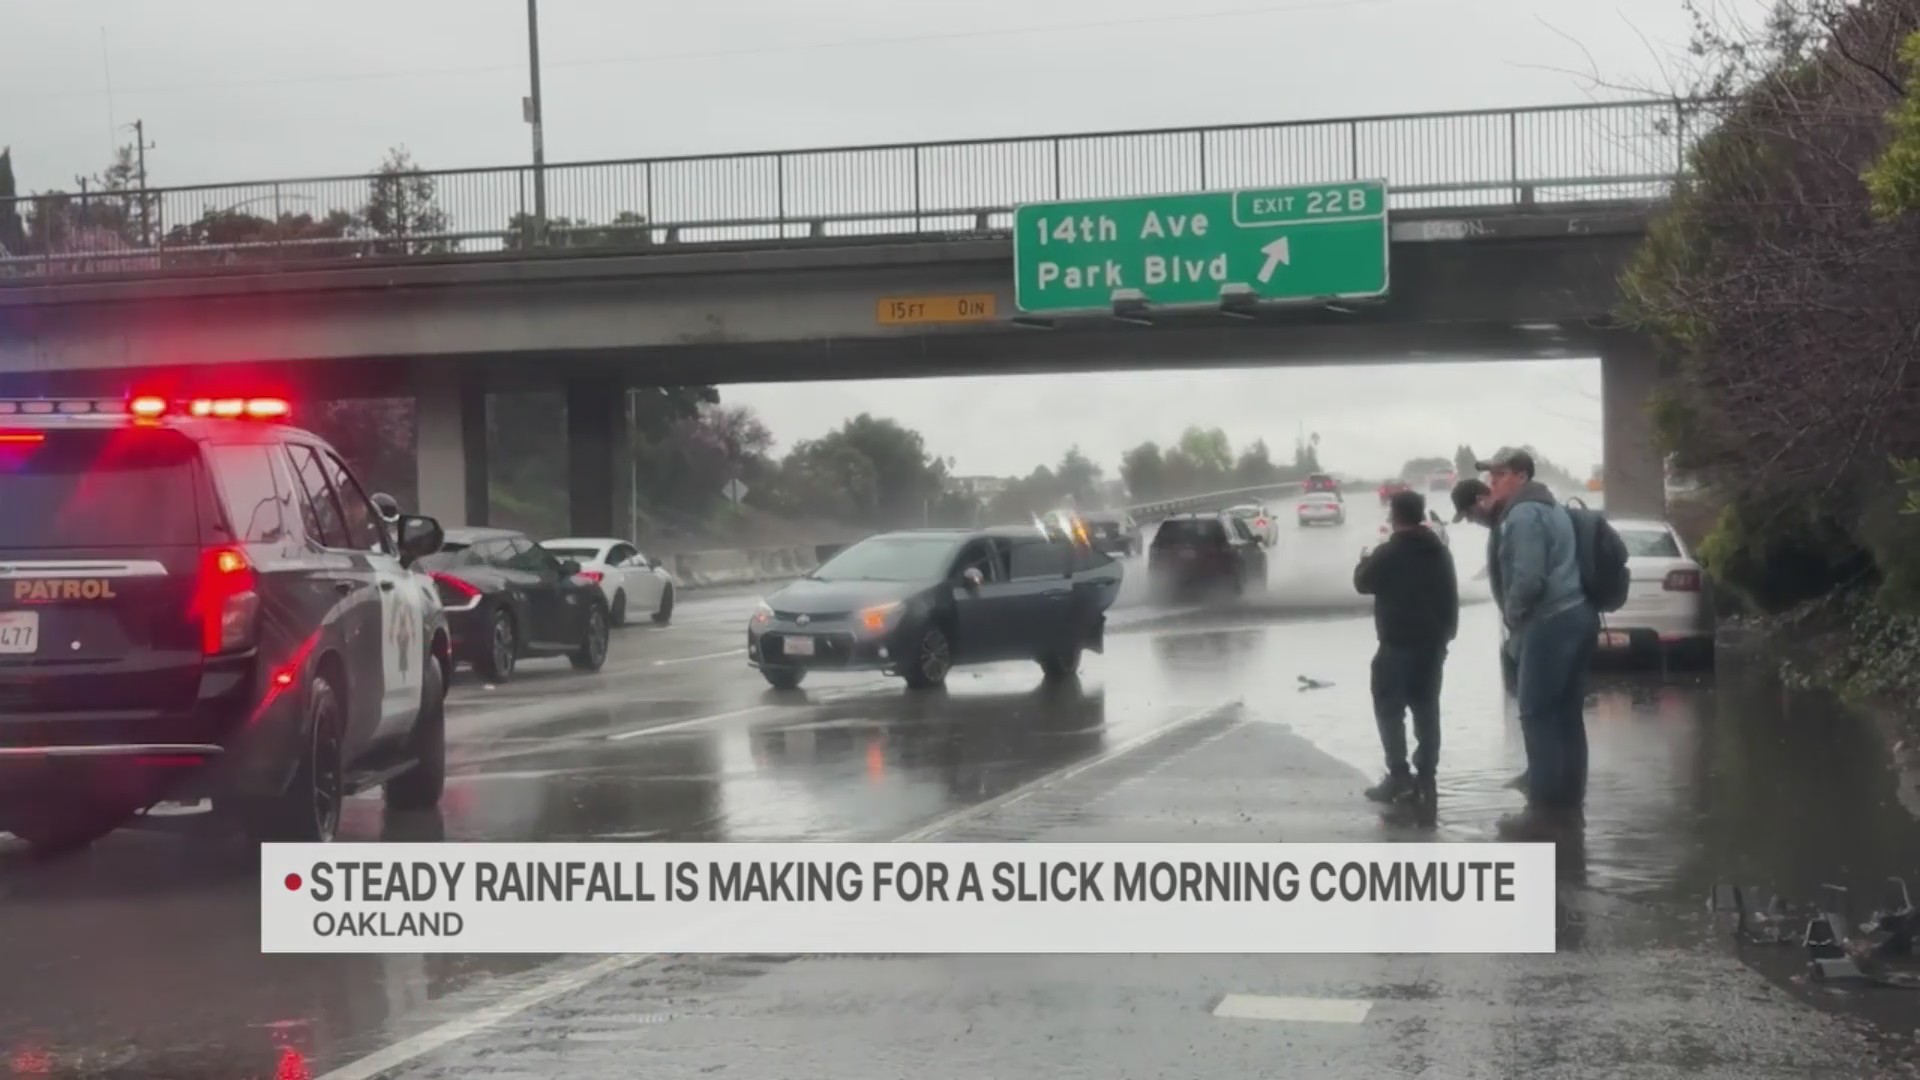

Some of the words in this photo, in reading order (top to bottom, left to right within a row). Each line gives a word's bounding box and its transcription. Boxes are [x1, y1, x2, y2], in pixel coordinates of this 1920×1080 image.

[1253, 196, 1294, 214] EXIT
[1307, 189, 1366, 214] 22B
[1037, 215, 1117, 245] 14th
[1140, 210, 1208, 239] Ave
[1038, 259, 1122, 290] Park
[1145, 253, 1227, 284] Blvd
[14, 579, 116, 599] PATROL
